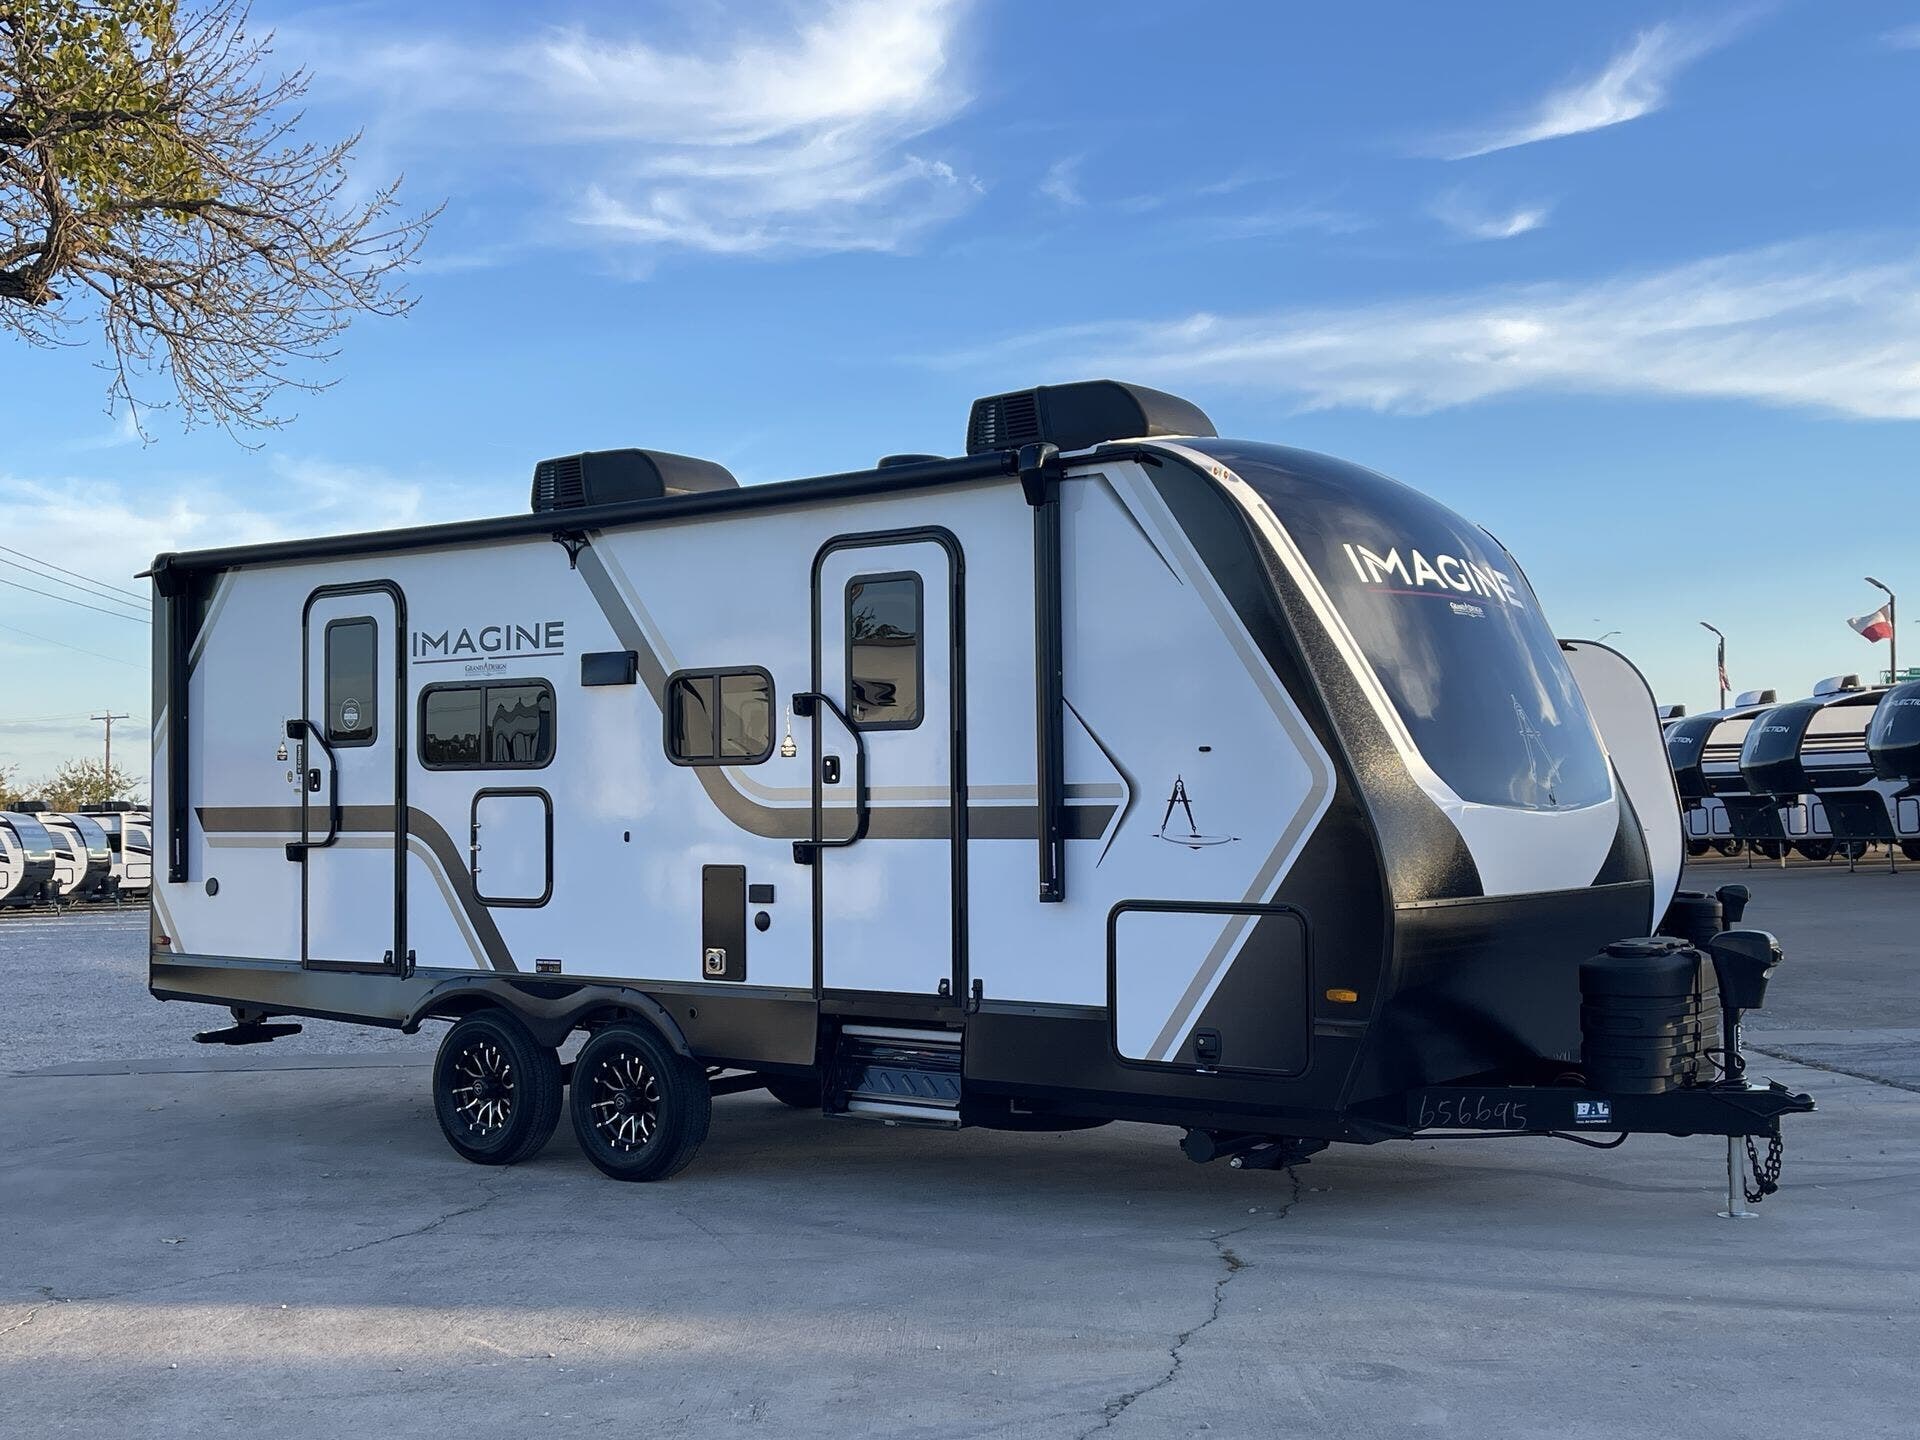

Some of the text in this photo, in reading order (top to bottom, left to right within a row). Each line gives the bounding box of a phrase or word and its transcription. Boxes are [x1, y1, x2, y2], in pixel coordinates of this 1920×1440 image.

[1342, 543, 1524, 609] IMAGINE
[412, 621, 564, 657] IMAGINE
[1419, 1095, 1527, 1128] 656695
